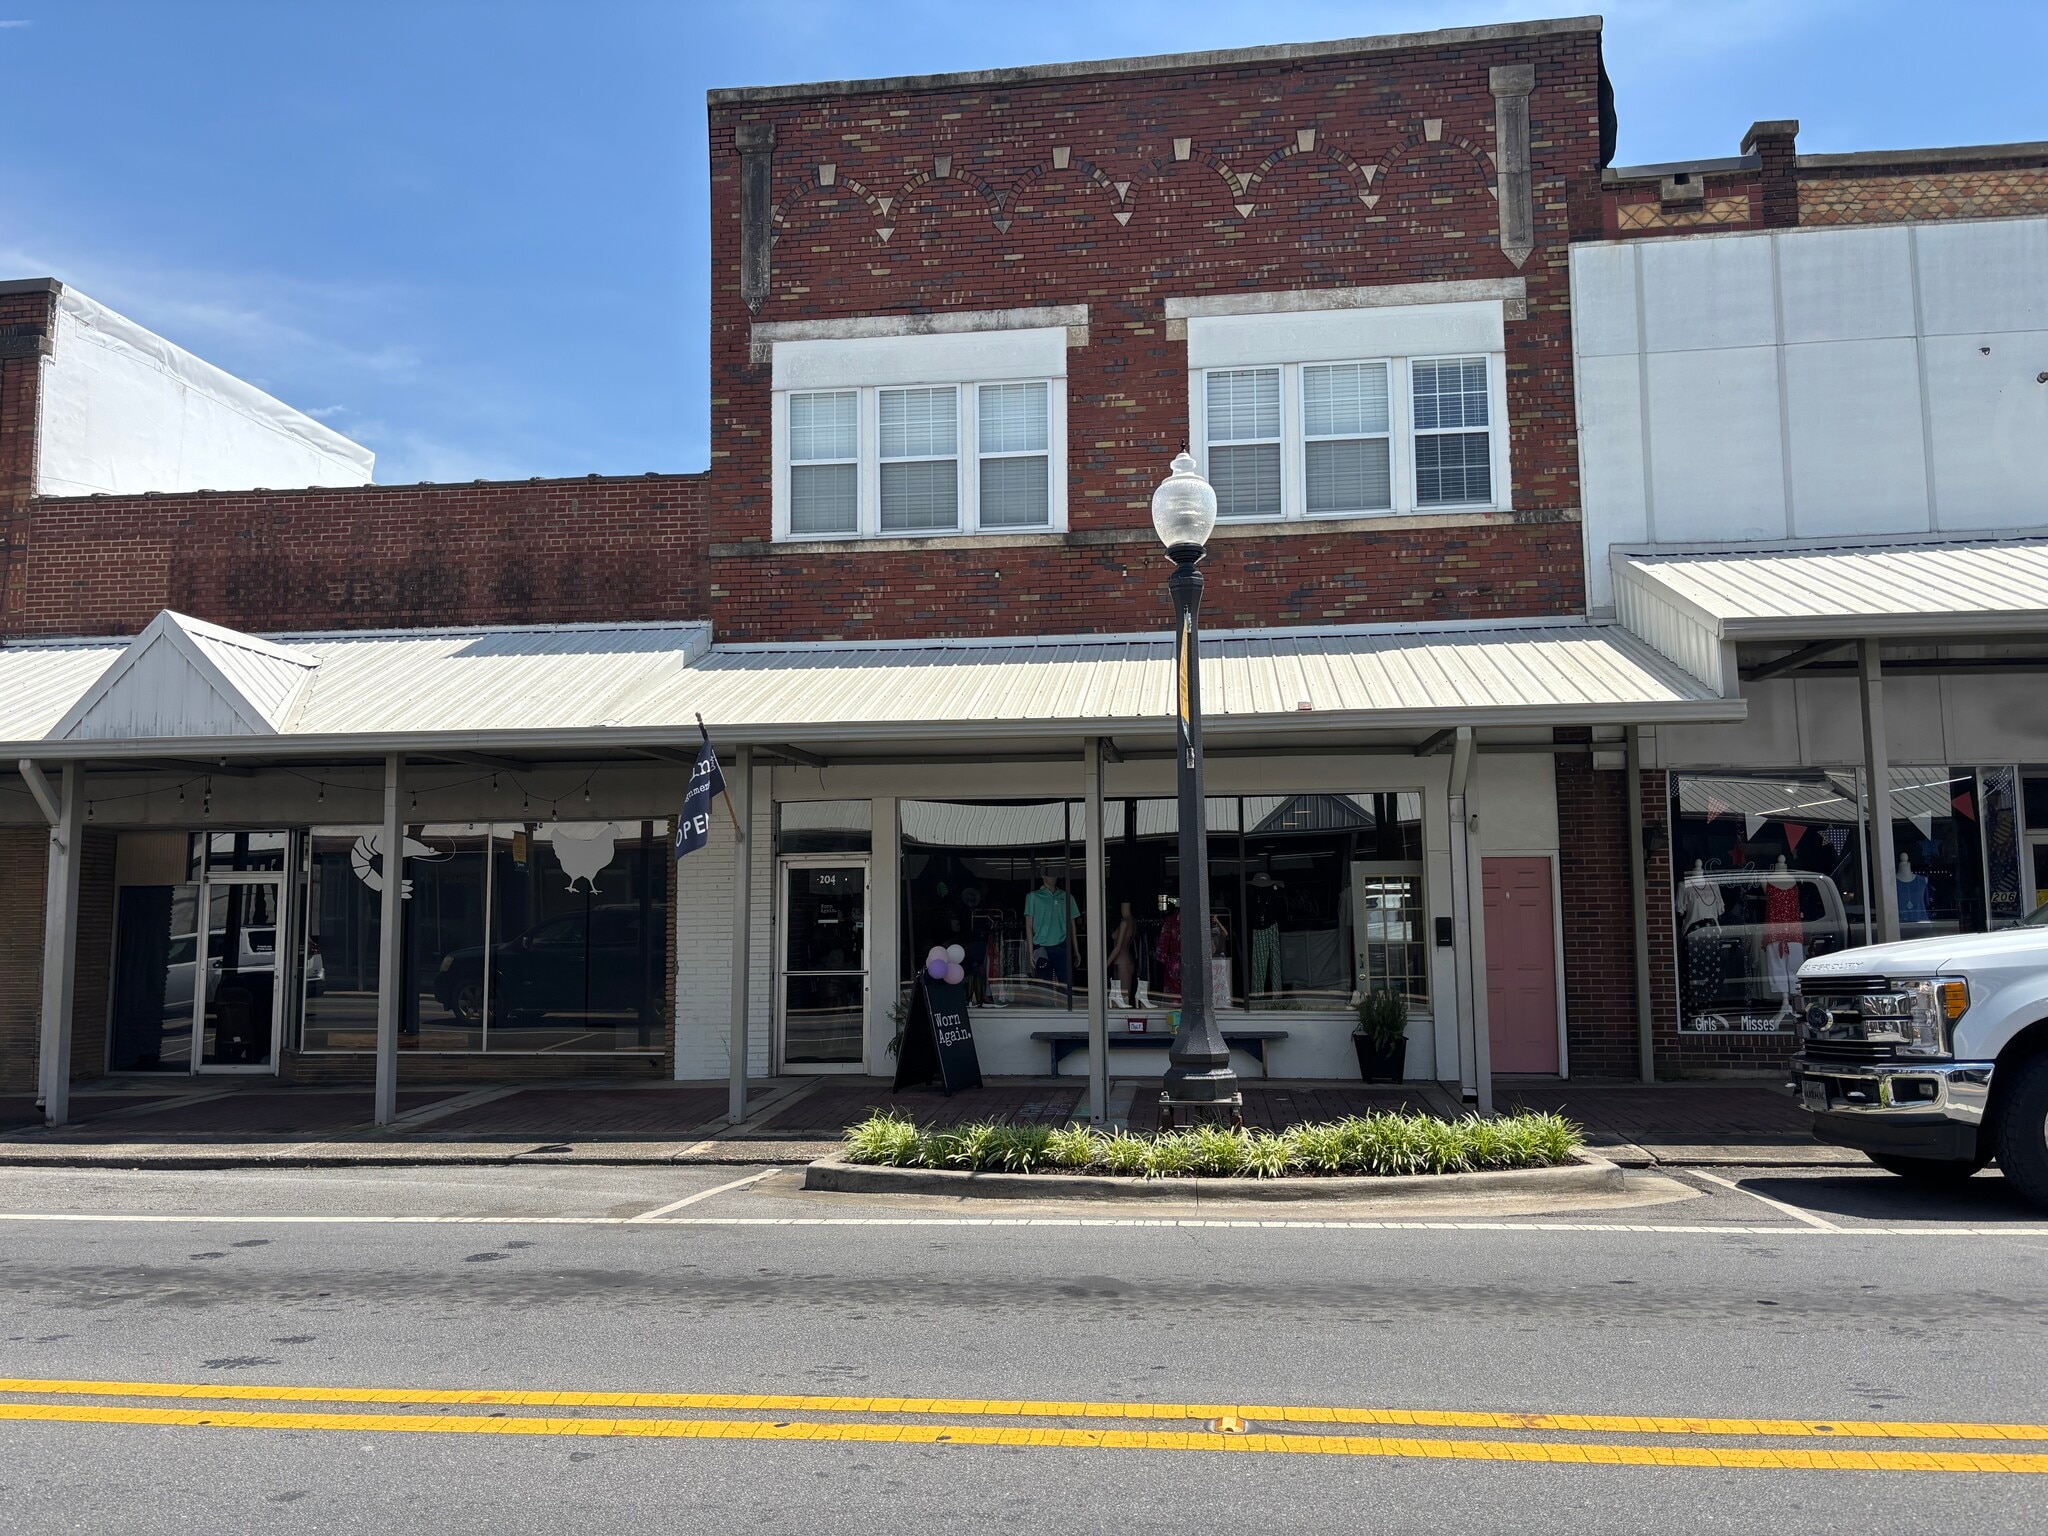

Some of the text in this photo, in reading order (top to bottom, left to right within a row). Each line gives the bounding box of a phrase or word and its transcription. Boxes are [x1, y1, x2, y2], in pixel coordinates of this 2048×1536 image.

[819, 874, 836, 885] 204
[1992, 892, 2015, 902] 206
[934, 1012, 961, 1027] Worn
[1695, 1015, 1775, 1031] Girls Misses
[939, 1027, 972, 1047] Again.
